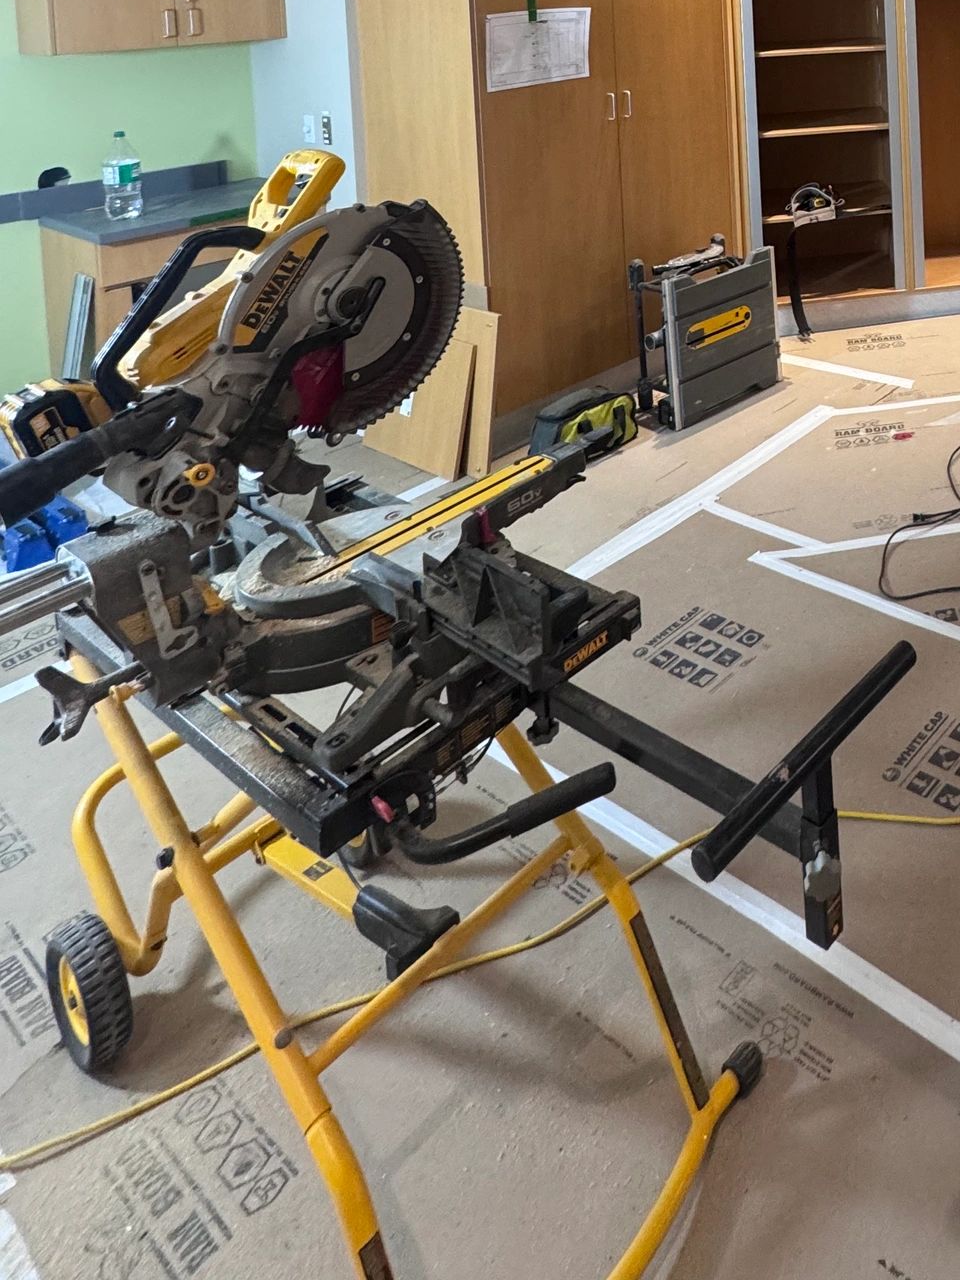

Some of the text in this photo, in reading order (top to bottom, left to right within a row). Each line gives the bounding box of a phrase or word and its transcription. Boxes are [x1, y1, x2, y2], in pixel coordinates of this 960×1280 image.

[242, 249, 302, 330] DEWALT
[847, 333, 903, 345] RAM BOARD
[834, 423, 905, 438] RAM BOARD
[645, 606, 700, 647] WHITE CAP
[563, 631, 608, 672] DEWALT
[894, 711, 945, 768] WHITE CAP
[15, 993, 56, 1039] RAM
[166, 1209, 221, 1276] RAM
